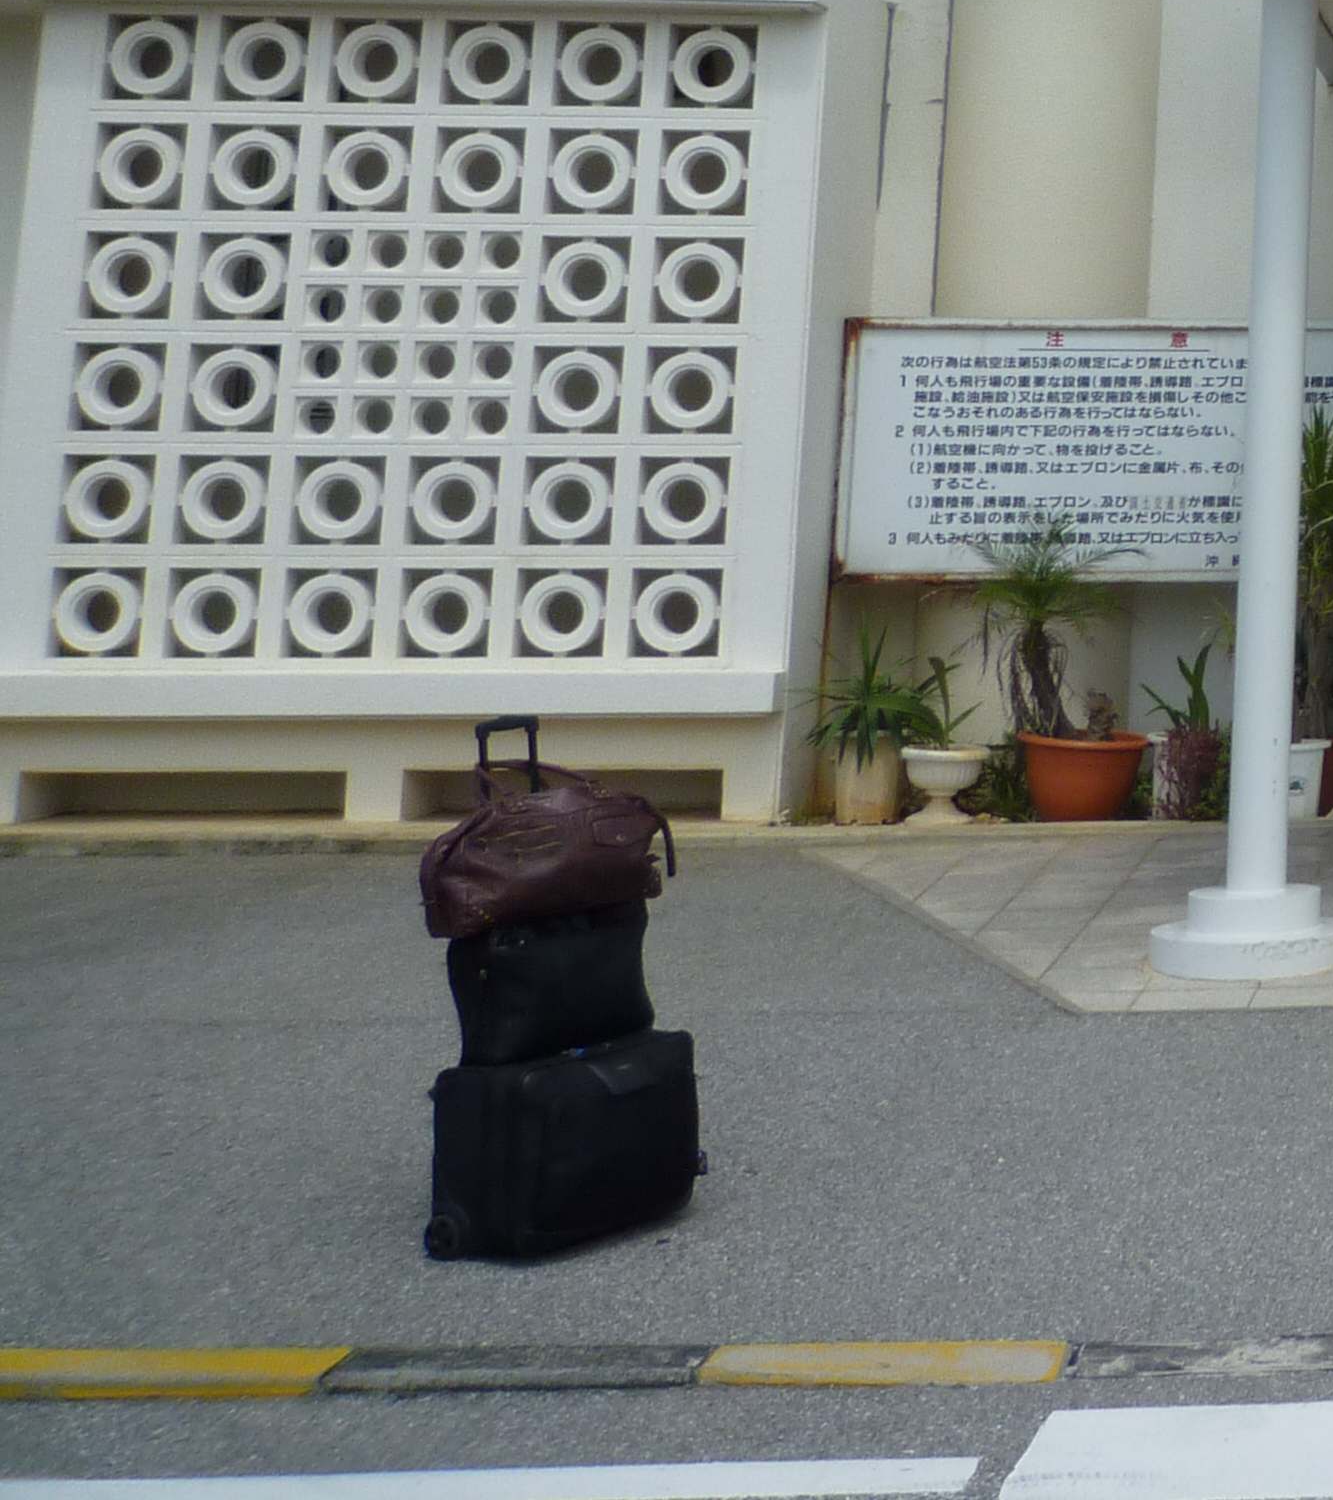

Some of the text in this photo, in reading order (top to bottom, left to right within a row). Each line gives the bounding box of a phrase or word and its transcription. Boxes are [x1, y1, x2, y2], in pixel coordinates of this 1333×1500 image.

[1045, 331, 1189, 348] 注 意
[931, 477, 997, 491] すること。
[1205, 554, 1219, 567] 沖
